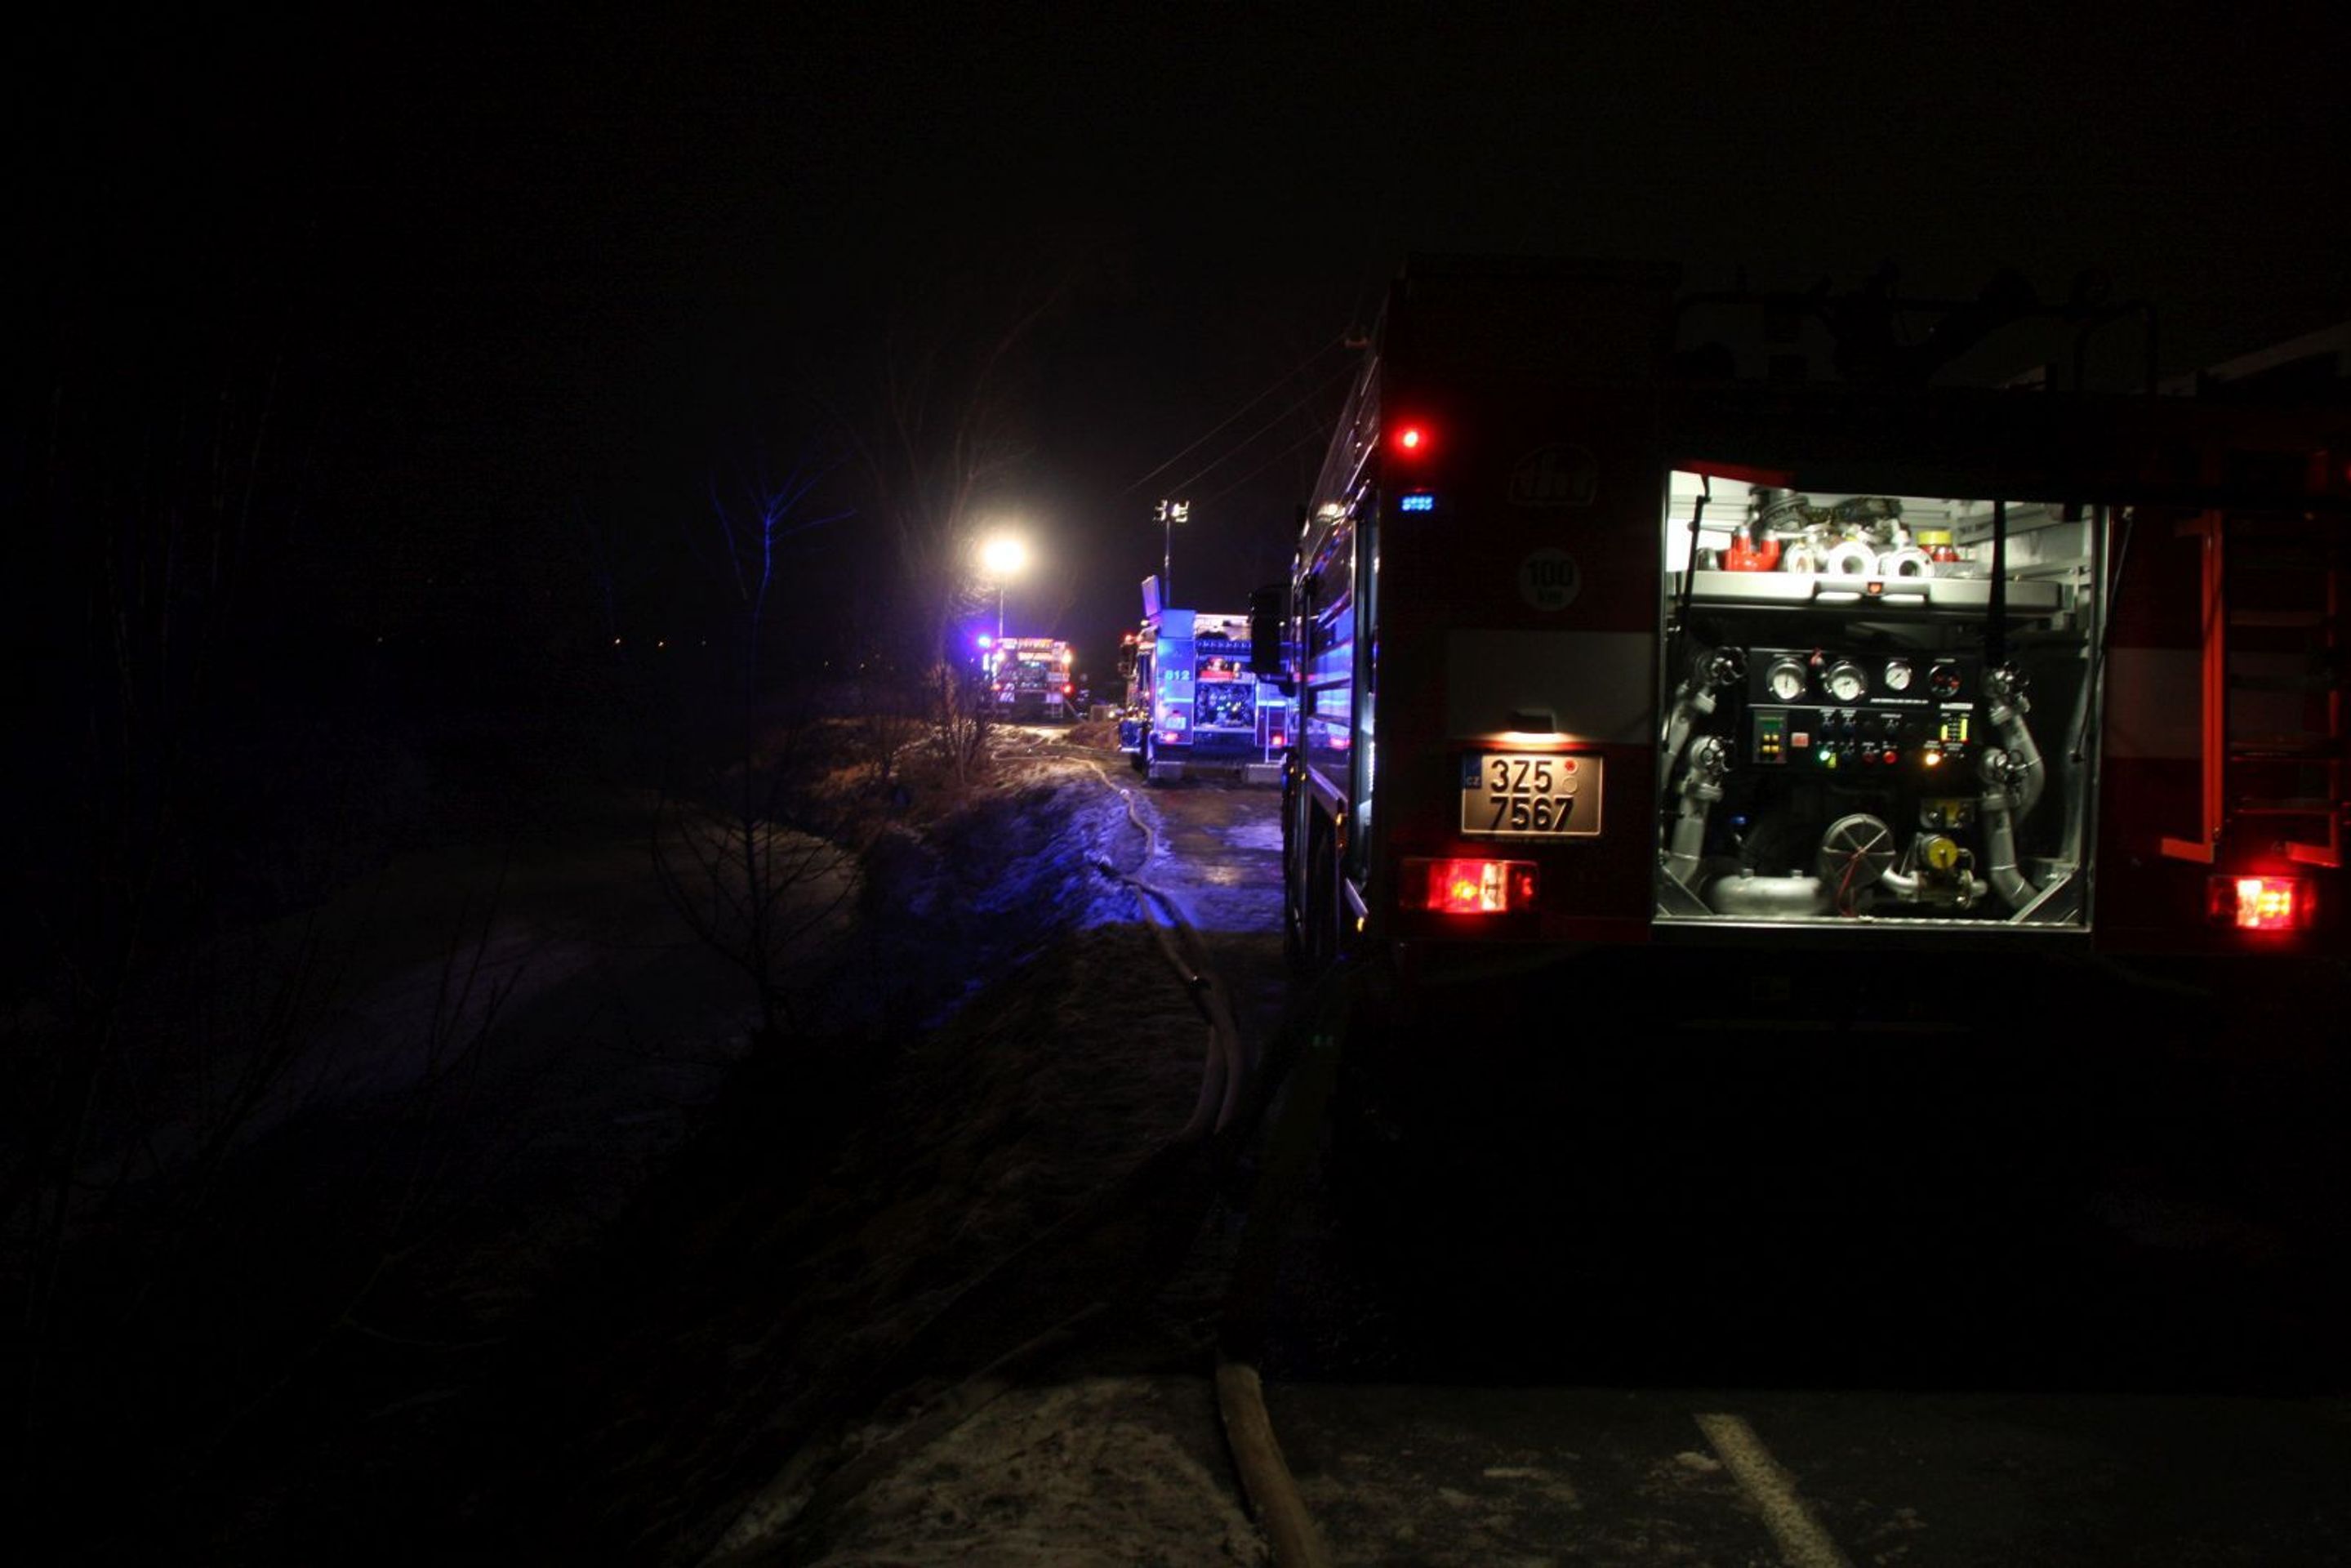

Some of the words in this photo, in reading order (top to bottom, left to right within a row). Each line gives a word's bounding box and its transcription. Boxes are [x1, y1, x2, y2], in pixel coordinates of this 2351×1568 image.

[1526, 560, 1574, 586] 100
[1490, 760, 1552, 793] 3Z5
[1490, 796, 1574, 831] 7567
